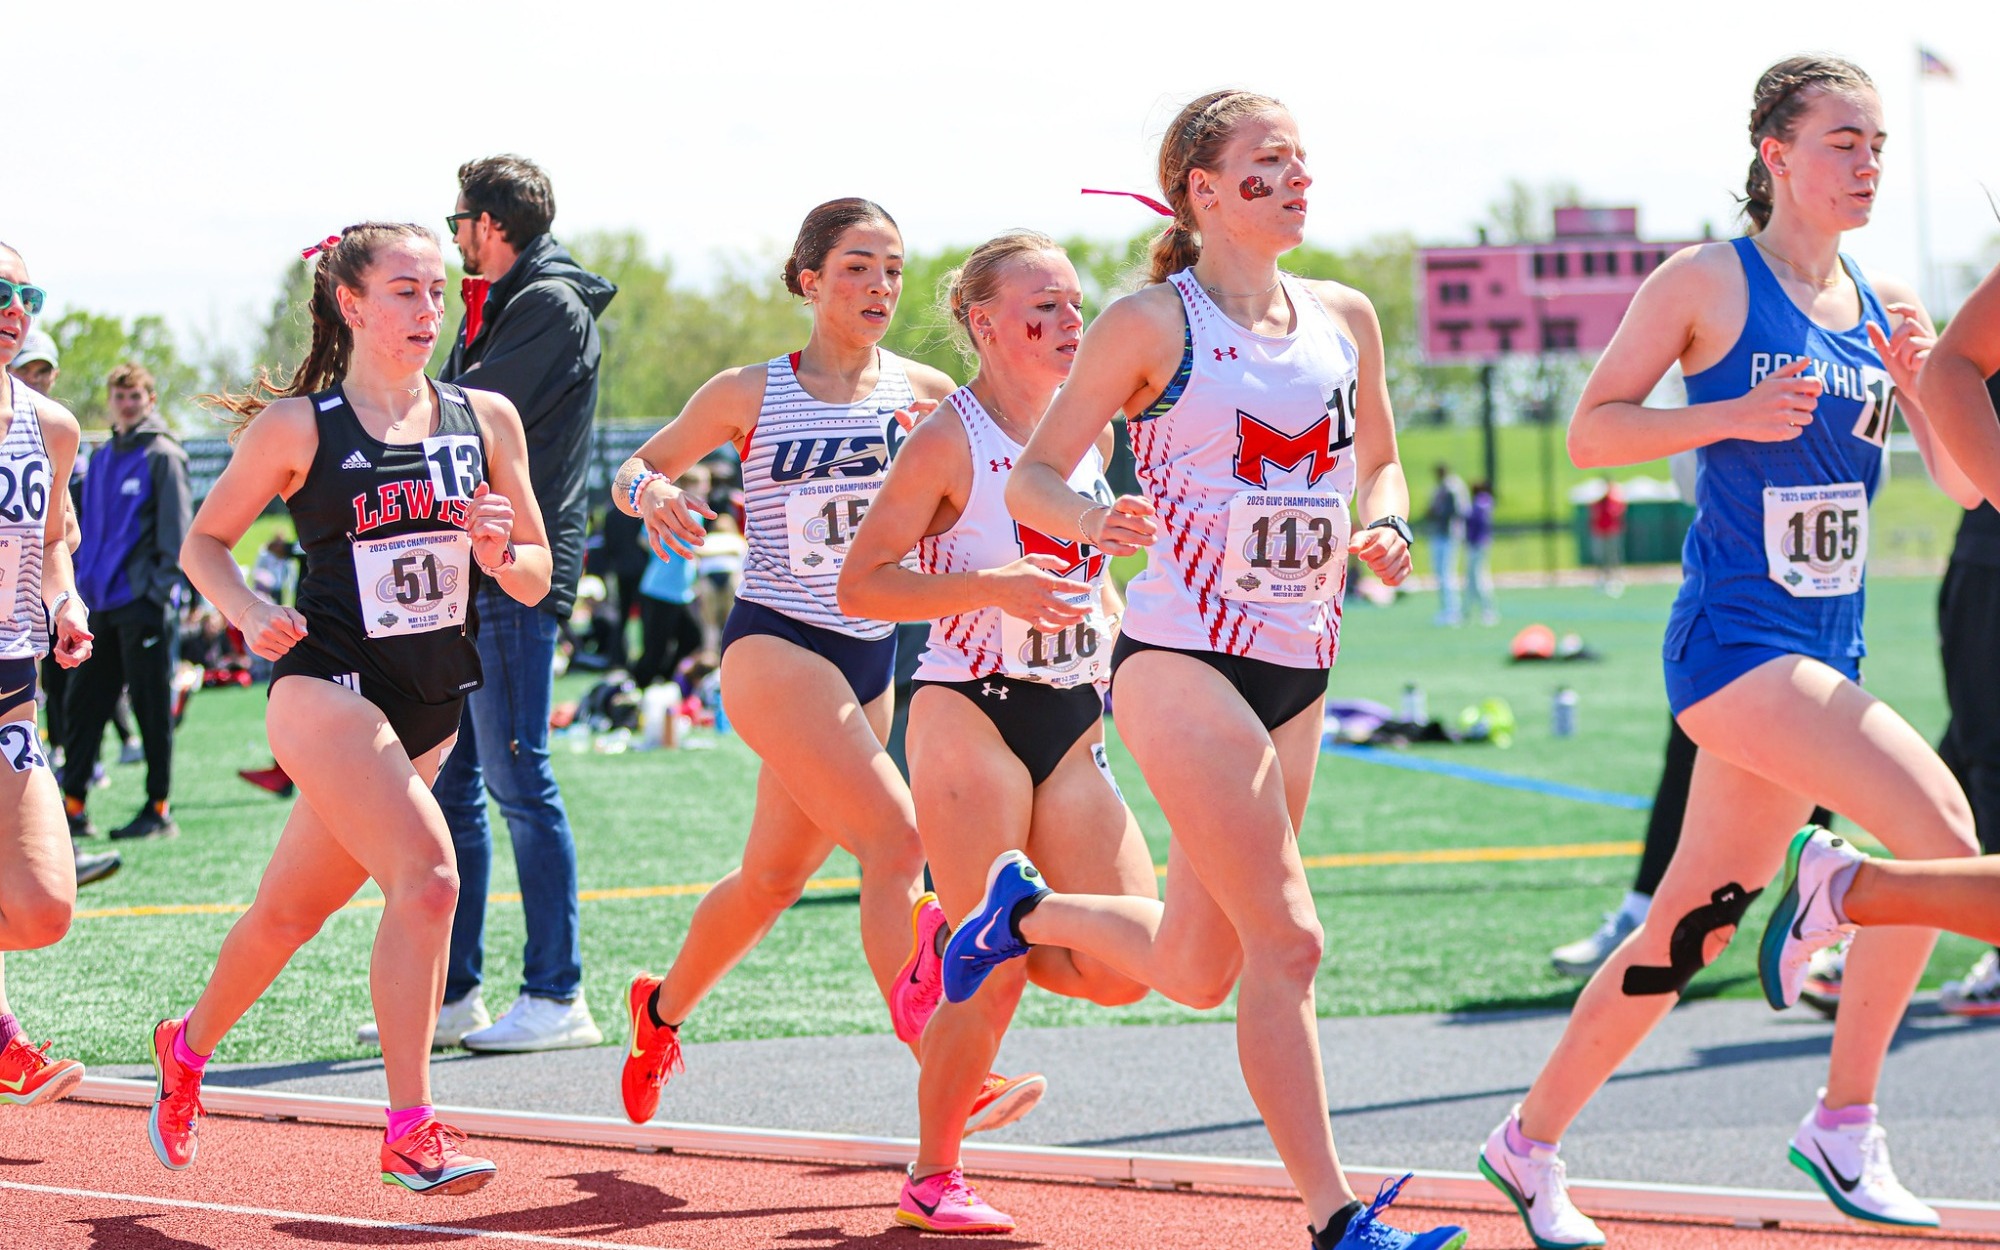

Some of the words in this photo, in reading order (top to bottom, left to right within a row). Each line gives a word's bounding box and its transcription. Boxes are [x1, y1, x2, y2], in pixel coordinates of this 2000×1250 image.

[341, 461, 372, 470] adidas
[428, 444, 482, 499] 13
[799, 486, 817, 496] 2025
[817, 485, 834, 494] GLVC
[835, 481, 885, 493] CHAMPIONSHIP
[1246, 495, 1265, 506] 2025
[1266, 496, 1283, 506] GLVC
[1284, 496, 1340, 508] CHAMPIONSHIPS
[368, 543, 388, 553] 2025
[388, 541, 406, 551] GLVC
[406, 534, 458, 548] CHAMPIONSHIPS
[1251, 516, 1333, 569] 113
[1789, 510, 1858, 563] 165
[392, 553, 444, 604] 51
[1293, 584, 1307, 592] 2025
[1027, 613, 1098, 669] 116
